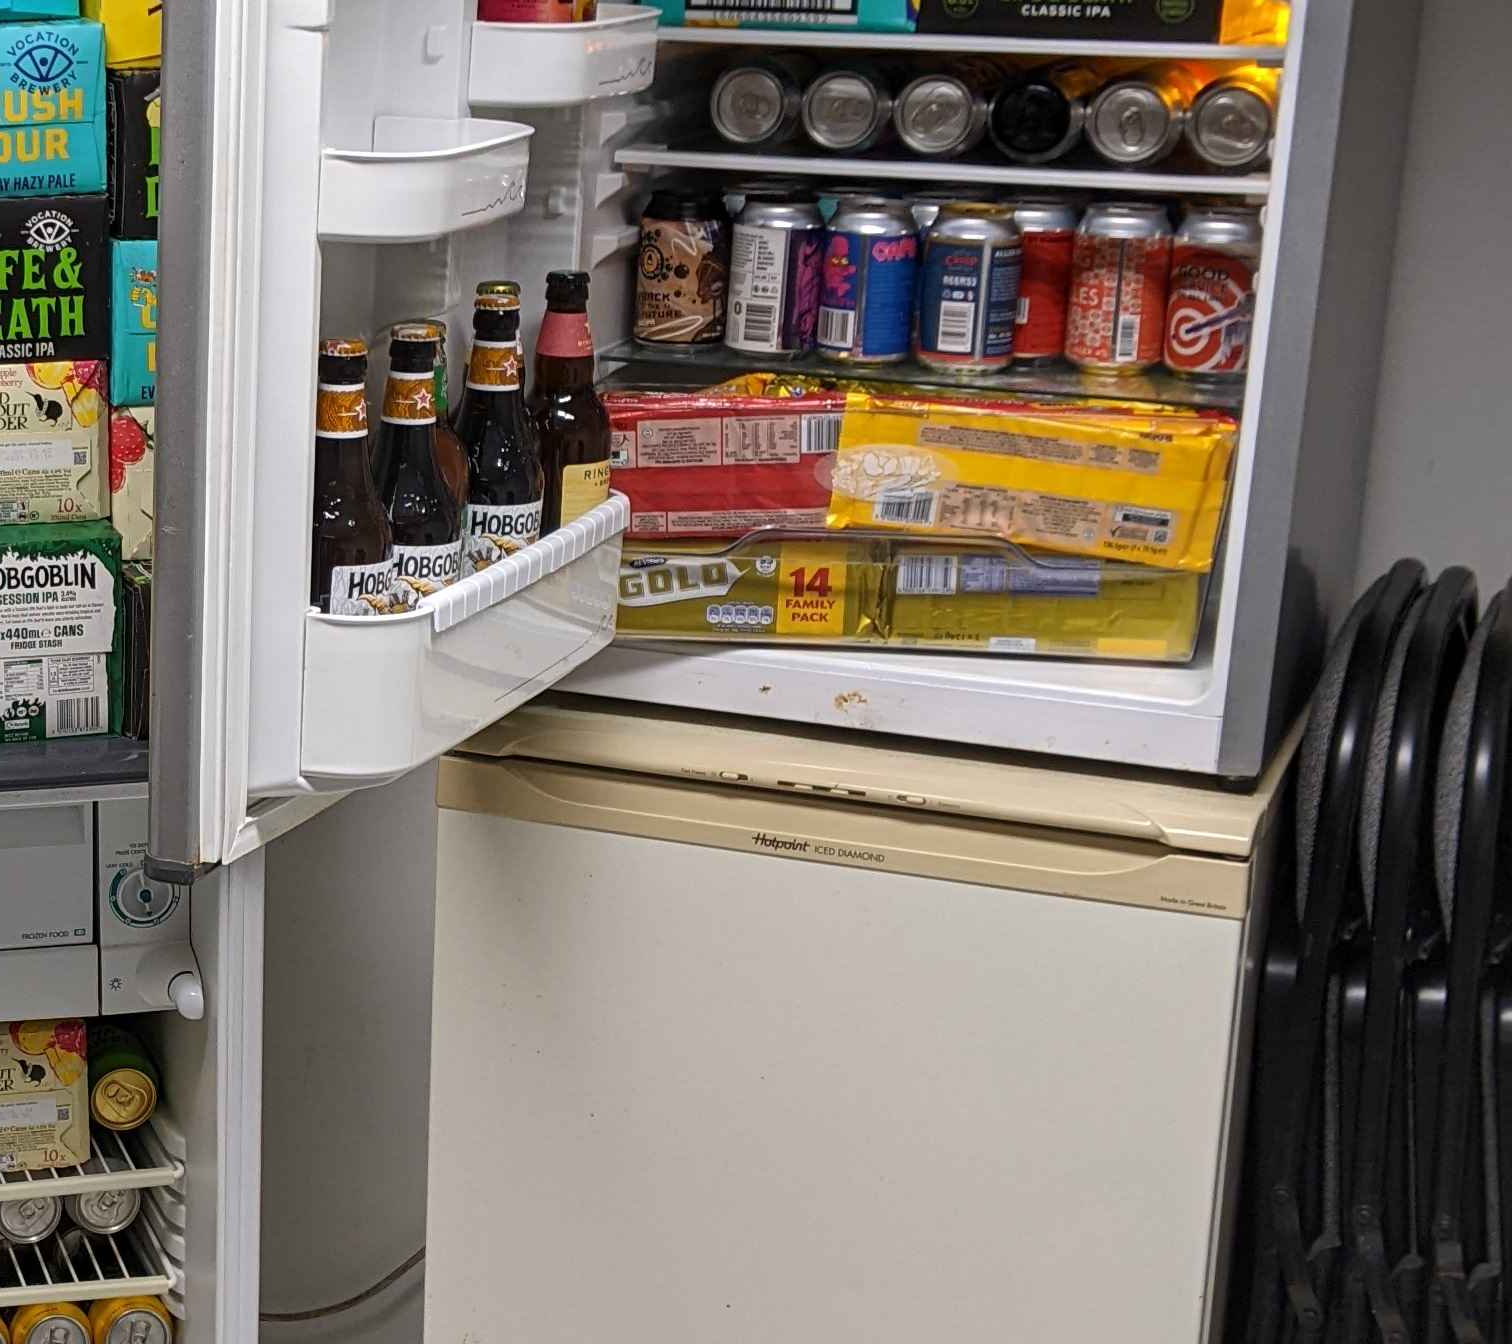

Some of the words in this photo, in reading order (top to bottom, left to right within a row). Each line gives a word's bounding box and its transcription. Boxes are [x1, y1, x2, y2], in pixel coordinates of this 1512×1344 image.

[1021, 4, 1082, 18] CLASSIC
[1085, 5, 1112, 19] IPA
[6, 31, 80, 58] VOCATION
[9, 69, 79, 97] BREWERY
[13, 174, 45, 191] HAZY
[47, 173, 76, 189] PALE
[25, 209, 74, 228] VOCATION
[25, 236, 73, 253] BREWERY
[52, 246, 85, 290] &
[35, 341, 56, 357] IPA
[619, 561, 729, 599] GOLD
[789, 567, 833, 598] 14
[42, 591, 59, 603] IPA
[785, 598, 837, 610] FAMILY
[791, 612, 829, 623] PACK
[53, 623, 84, 638] CANS
[10, 640, 37, 651] FRIDGE
[38, 639, 63, 649] STASH
[751, 831, 811, 854] Hotpoint
[814, 844, 836, 856] ICED
[837, 847, 886, 864] DIAMOND
